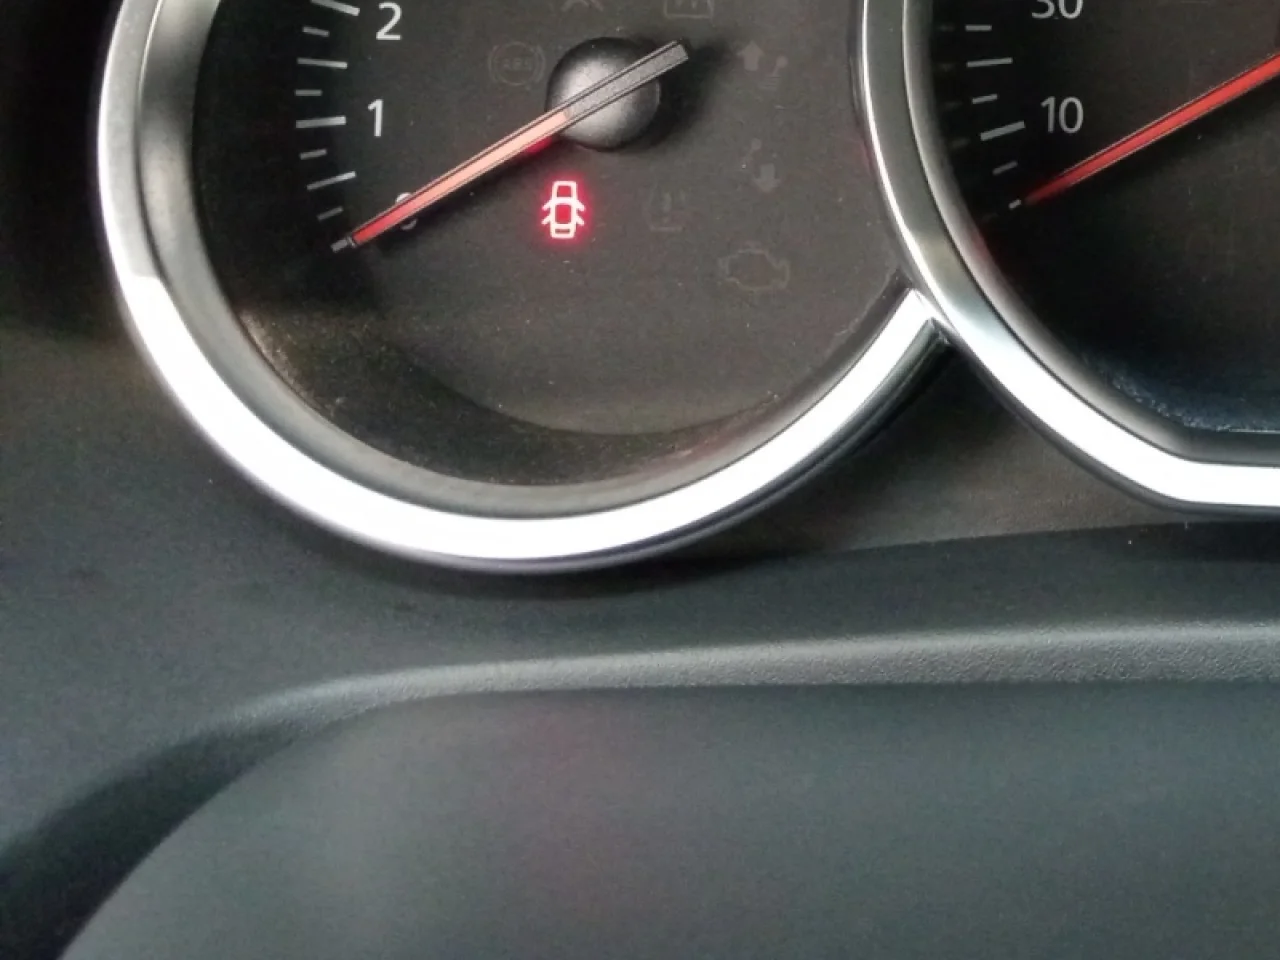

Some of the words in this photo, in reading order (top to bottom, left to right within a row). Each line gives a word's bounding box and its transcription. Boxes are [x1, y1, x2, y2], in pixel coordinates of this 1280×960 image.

[375, 1, 402, 41] 2
[367, 98, 383, 137] 1
[1041, 96, 1084, 134] 10
